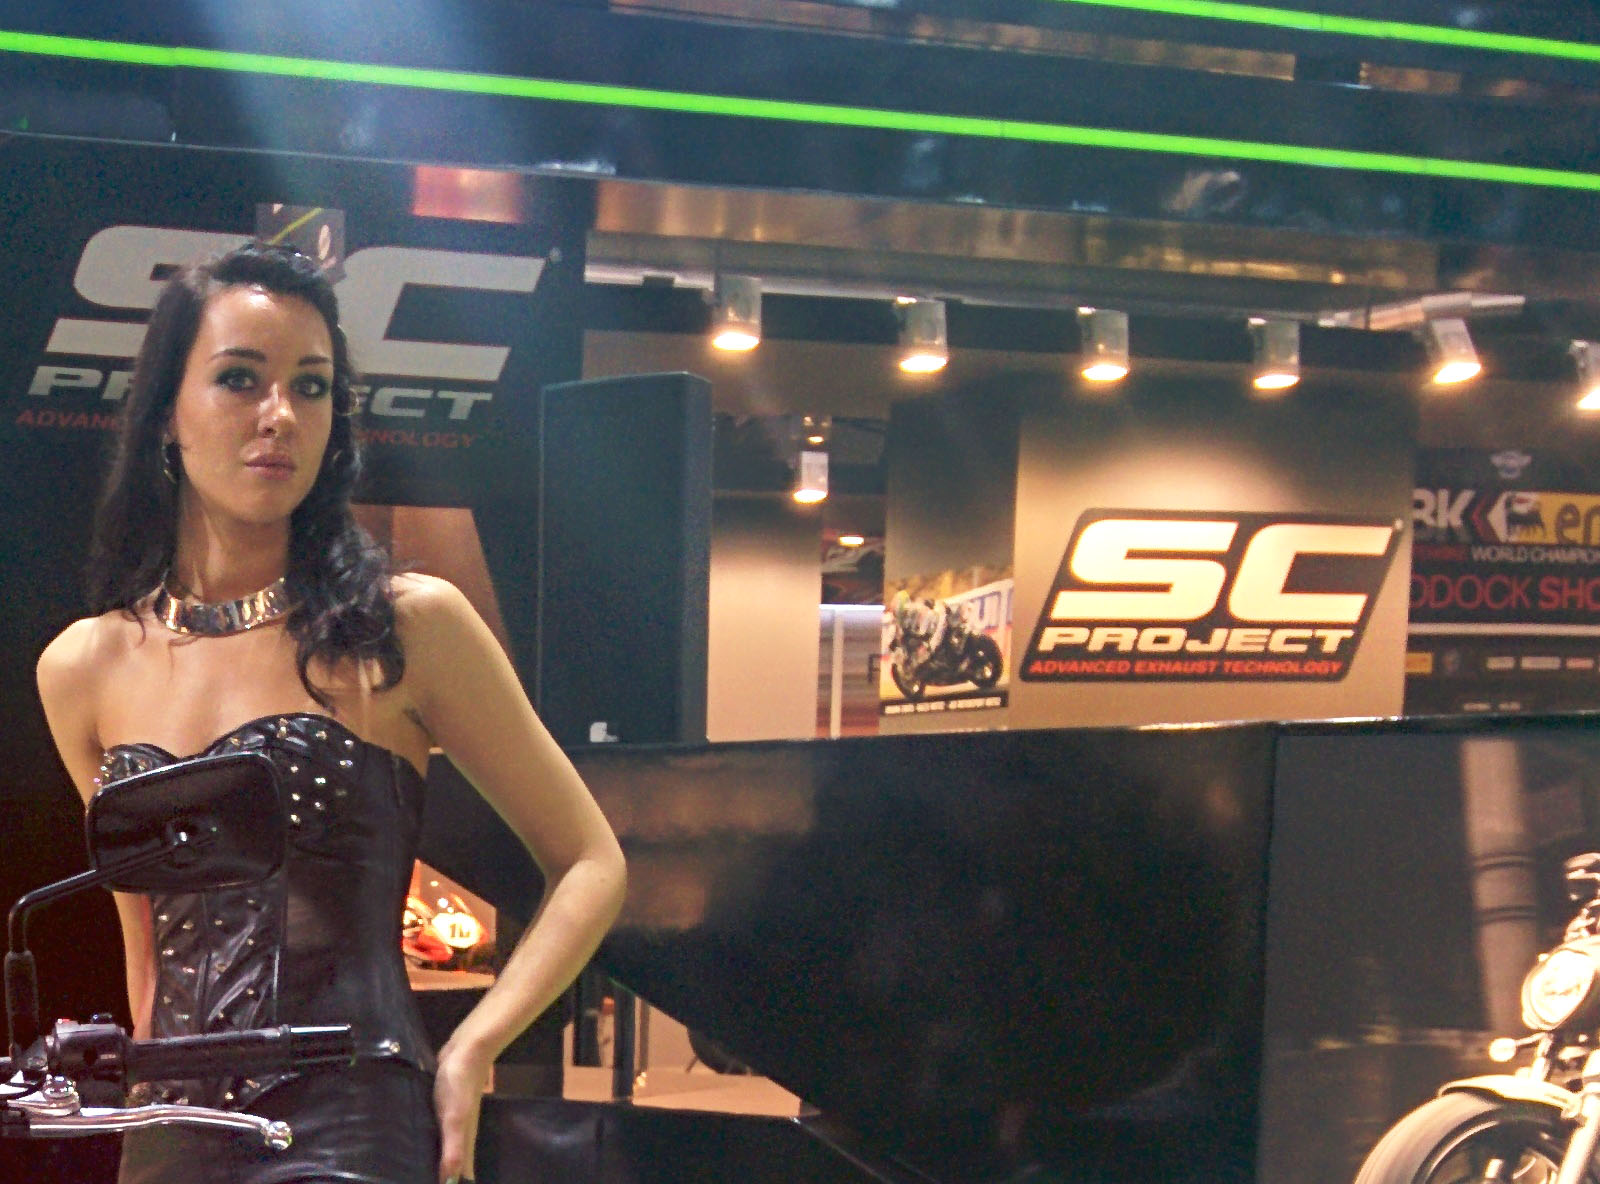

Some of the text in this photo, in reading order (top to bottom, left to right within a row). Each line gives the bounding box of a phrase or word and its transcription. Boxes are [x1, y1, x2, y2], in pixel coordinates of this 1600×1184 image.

[1050, 518, 1394, 623] SC
[1037, 626, 1356, 654] PROJECT
[1029, 659, 1344, 675] ADVANCED EXHAUST TECHNOLOGY
